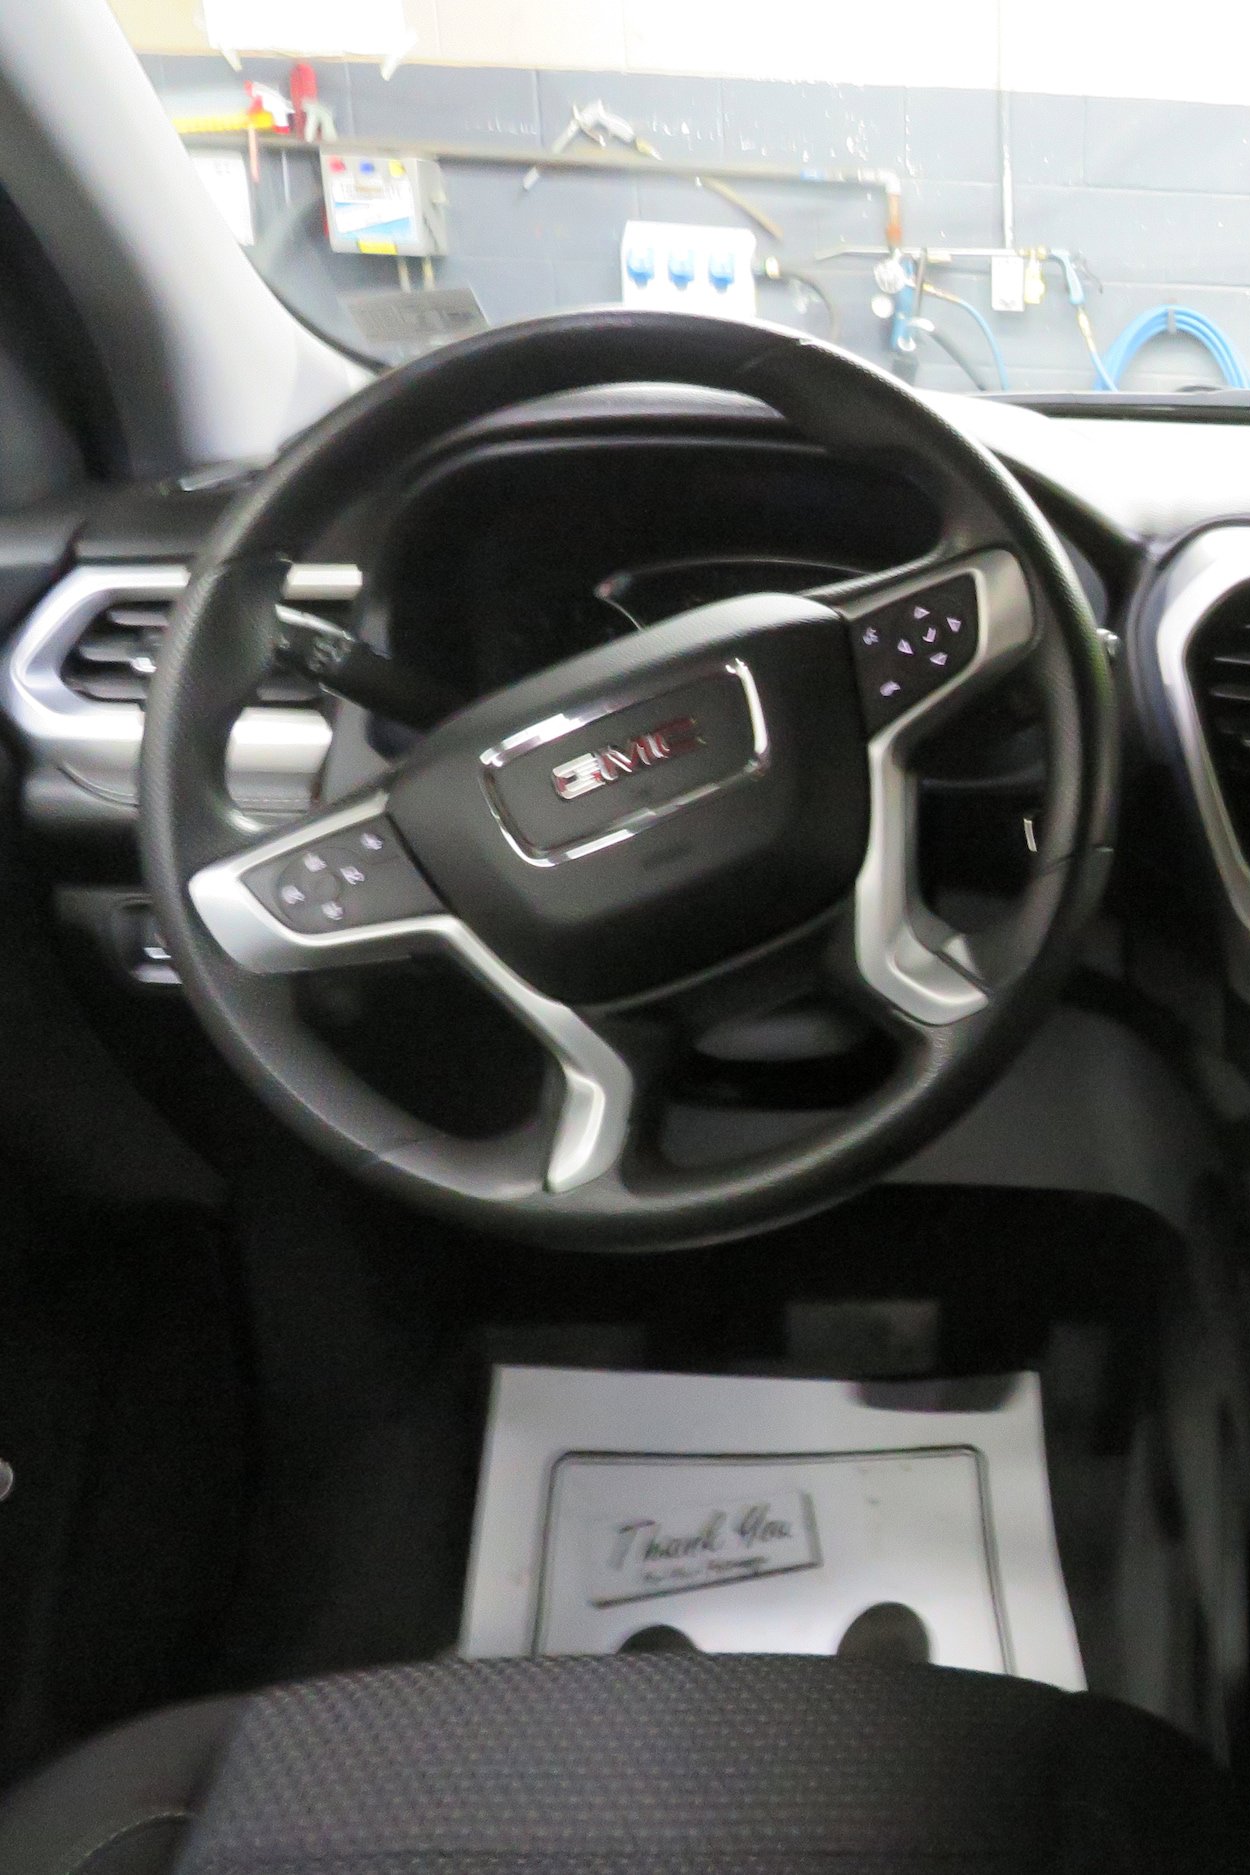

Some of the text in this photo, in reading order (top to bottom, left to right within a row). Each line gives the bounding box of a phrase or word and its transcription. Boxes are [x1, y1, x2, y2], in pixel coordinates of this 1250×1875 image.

[552, 714, 706, 800] GMC
[608, 1510, 727, 1570] Thank
[732, 1502, 792, 1550] You
